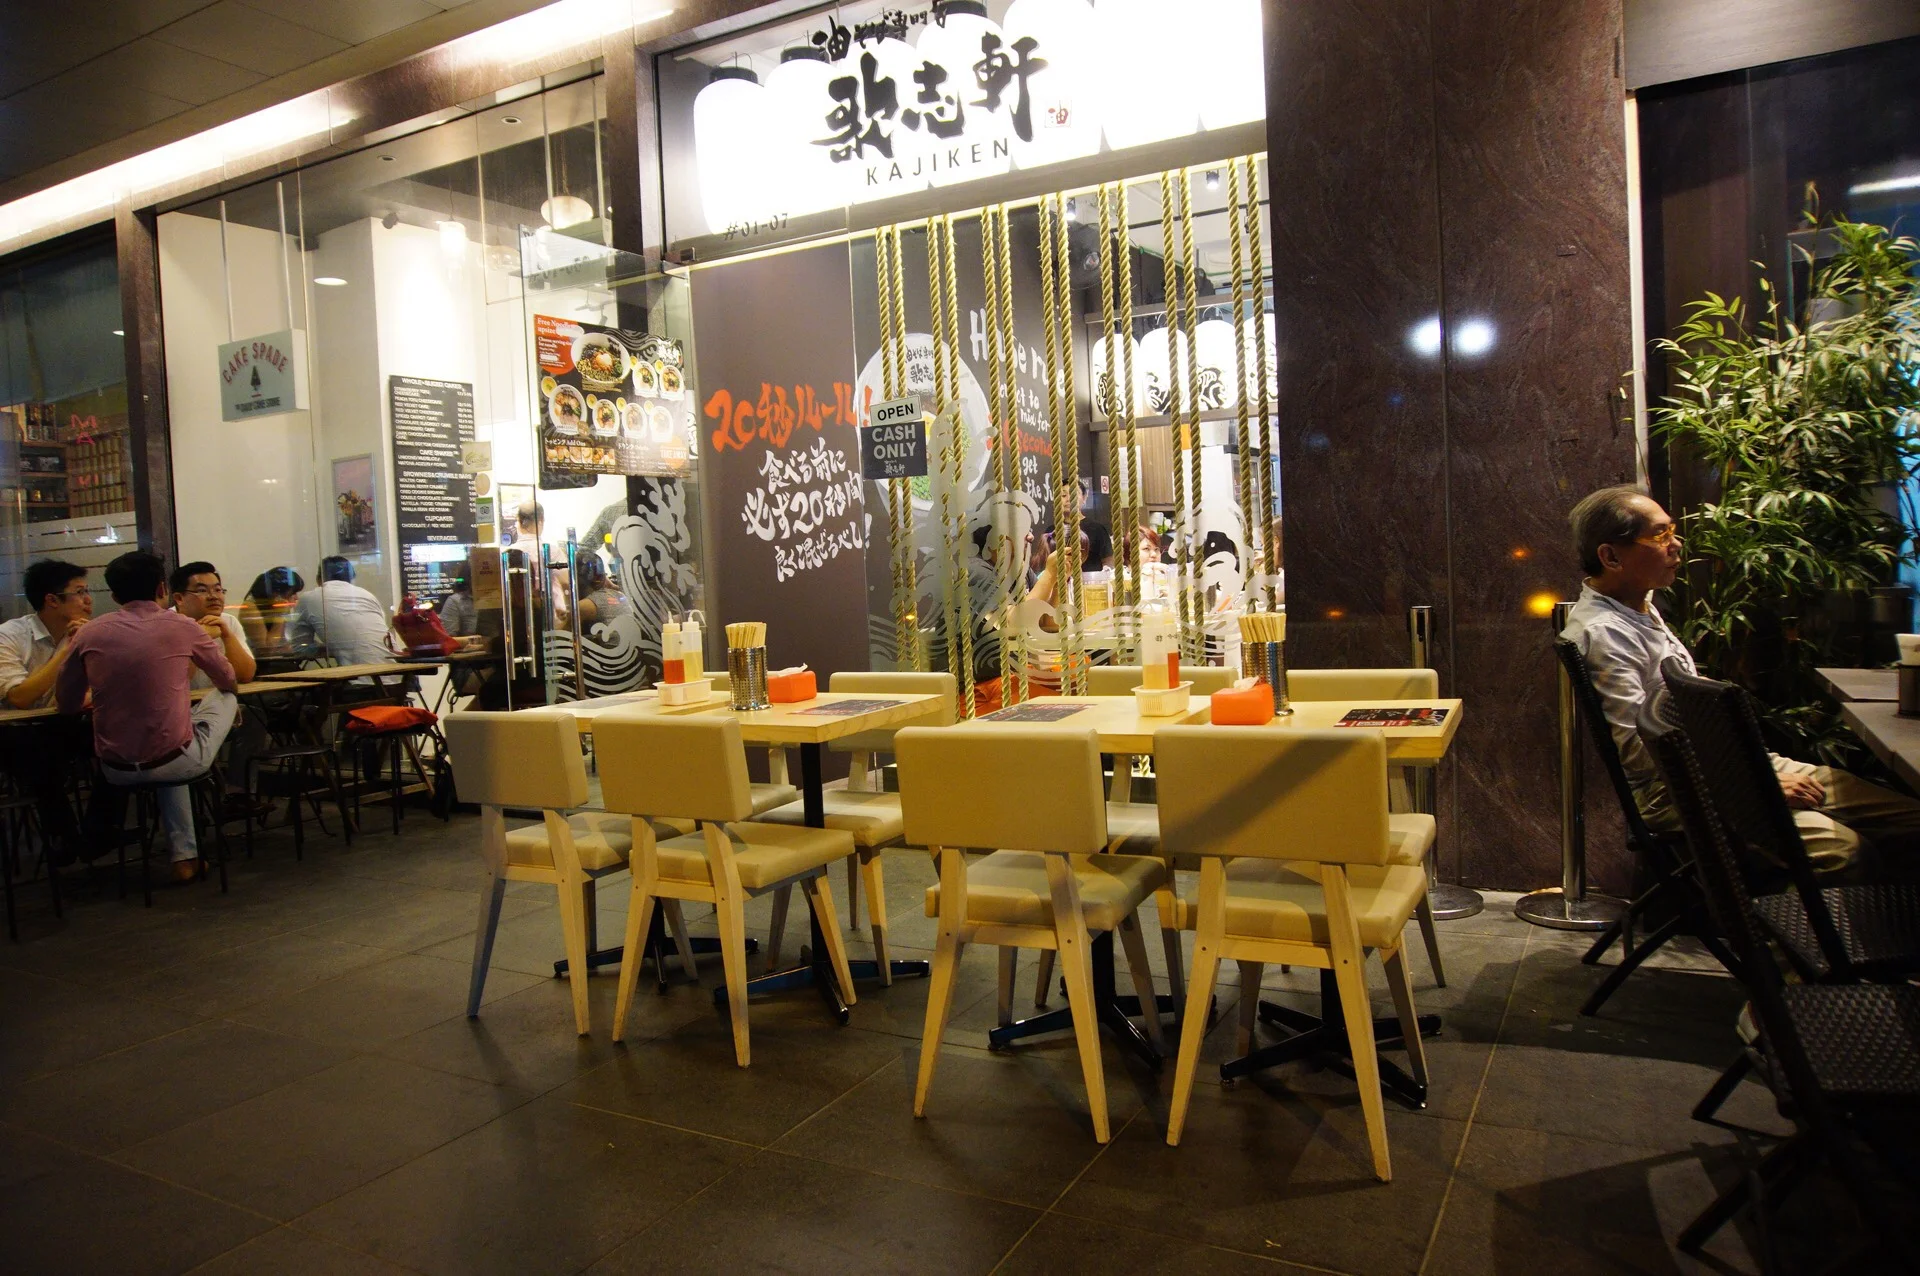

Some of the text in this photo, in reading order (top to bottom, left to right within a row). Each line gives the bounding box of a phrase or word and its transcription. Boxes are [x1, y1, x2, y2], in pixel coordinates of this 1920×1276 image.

[866, 137, 1010, 186] KAJIKEN
[723, 213, 788, 240] #01-07
[222, 342, 288, 386] CAKE SPADE
[877, 403, 914, 421] OPEN
[872, 425, 916, 442] CASH
[873, 442, 916, 460] ONLY
[758, 437, 847, 494] 食べる前に
[1022, 455, 1039, 476] get
[1024, 476, 1041, 499] the
[741, 470, 865, 541] 必ず20秒間
